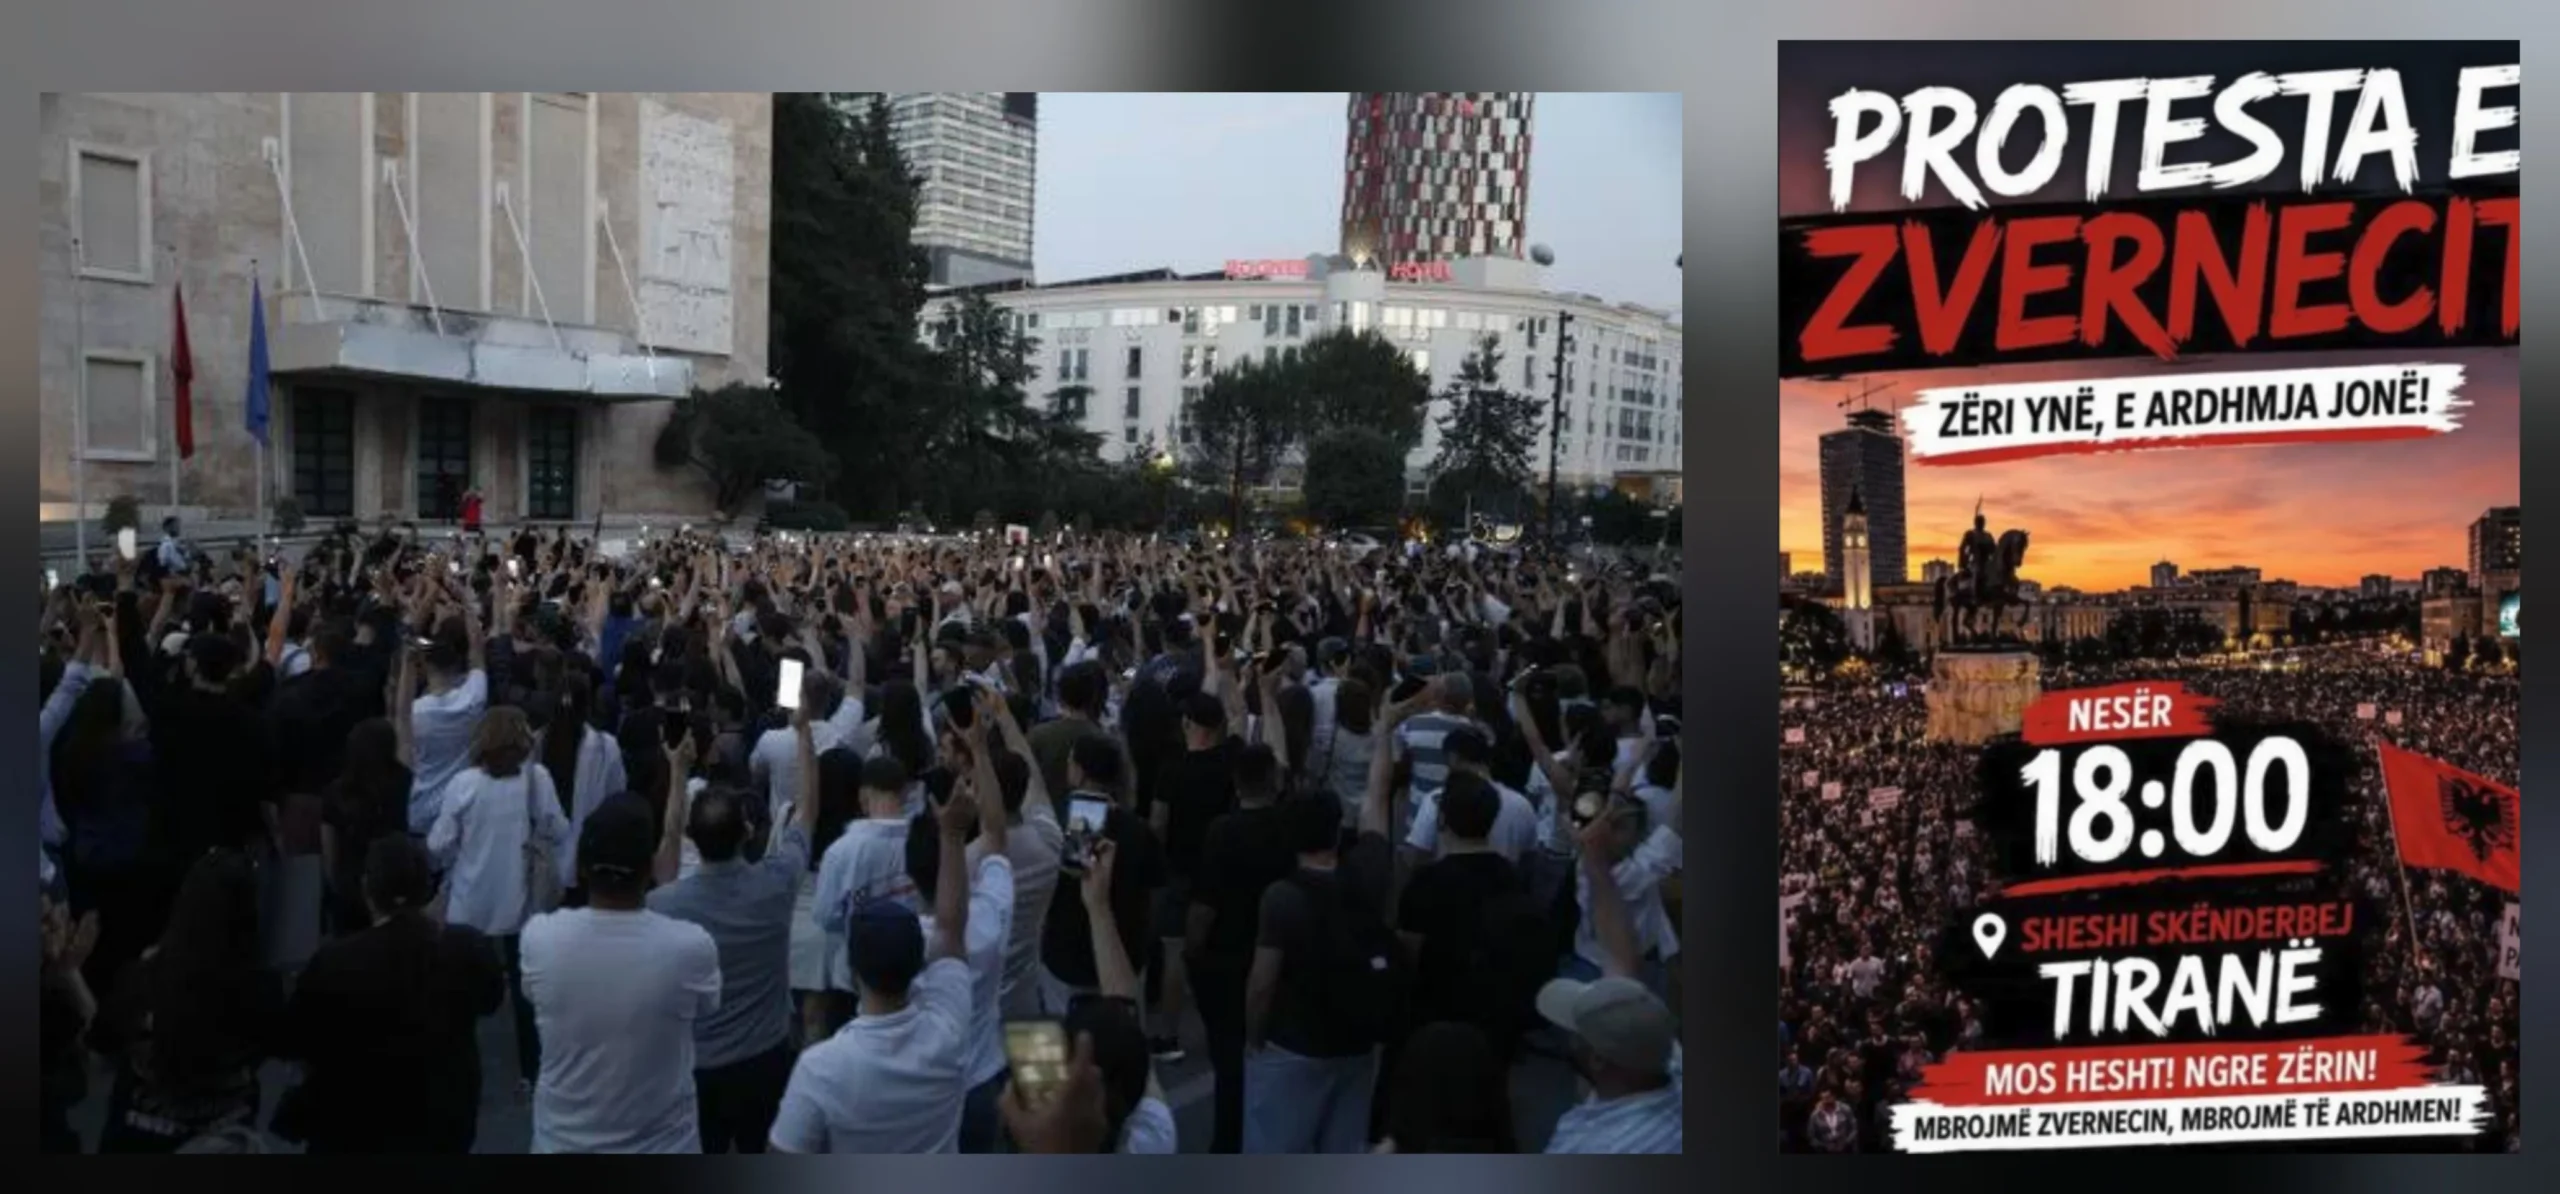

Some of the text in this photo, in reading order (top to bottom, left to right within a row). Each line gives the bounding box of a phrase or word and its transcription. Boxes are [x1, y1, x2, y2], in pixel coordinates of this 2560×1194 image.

[1826, 65, 2520, 211] PROTESTA E
[1940, 371, 2428, 438] ZËRI YNË, E ARDHMJA JONË!
[2070, 689, 2171, 730] NESËR
[2021, 737, 2308, 865] 18:00
[2024, 906, 2350, 949] SHESHI SKËNDERBEJ
[2040, 939, 2321, 1037] TIRANË
[1987, 1046, 2375, 1094] MOS HESHT! NGRE ZËRIN!
[1915, 1099, 2460, 1139] MBROJMË ZVERNECIN, MBROJMË TË ARDHMEN!
